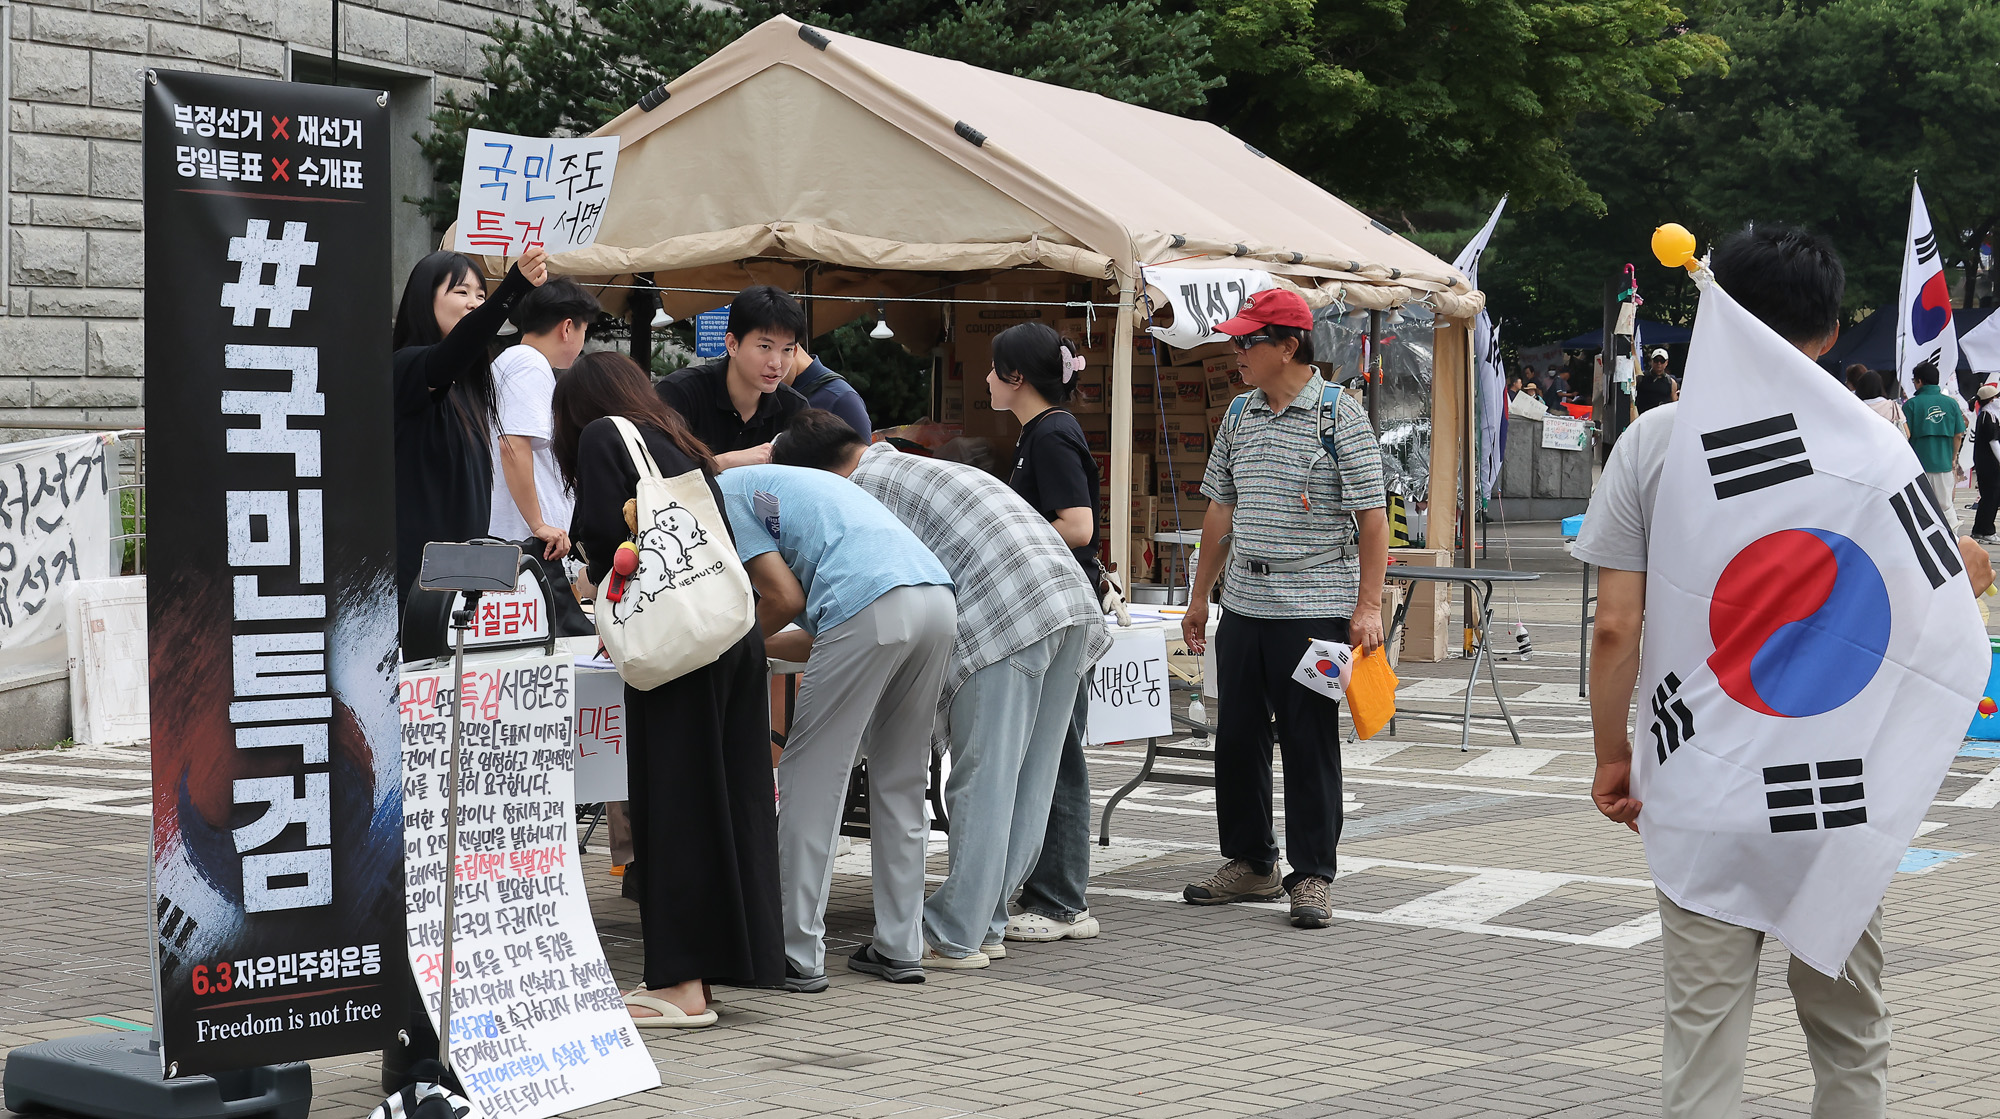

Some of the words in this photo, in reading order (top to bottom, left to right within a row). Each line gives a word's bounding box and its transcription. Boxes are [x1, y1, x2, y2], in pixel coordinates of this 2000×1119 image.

[173, 103, 263, 141] 부정선거
[297, 115, 362, 149] 재선거
[176, 145, 263, 182] 당일투표
[298, 156, 364, 189] 수개표
[679, 560, 723, 588] NEMUIYO
[1090, 658, 1161, 708] 서명운동
[575, 704, 623, 758] 민특
[401, 748, 437, 771] 건에
[403, 809, 435, 832] 떠한
[405, 860, 447, 887] 해서는
[196, 1013, 283, 1043] Freedom
[288, 1007, 304, 1031] is
[309, 1004, 341, 1028] not
[344, 999, 382, 1023] free
